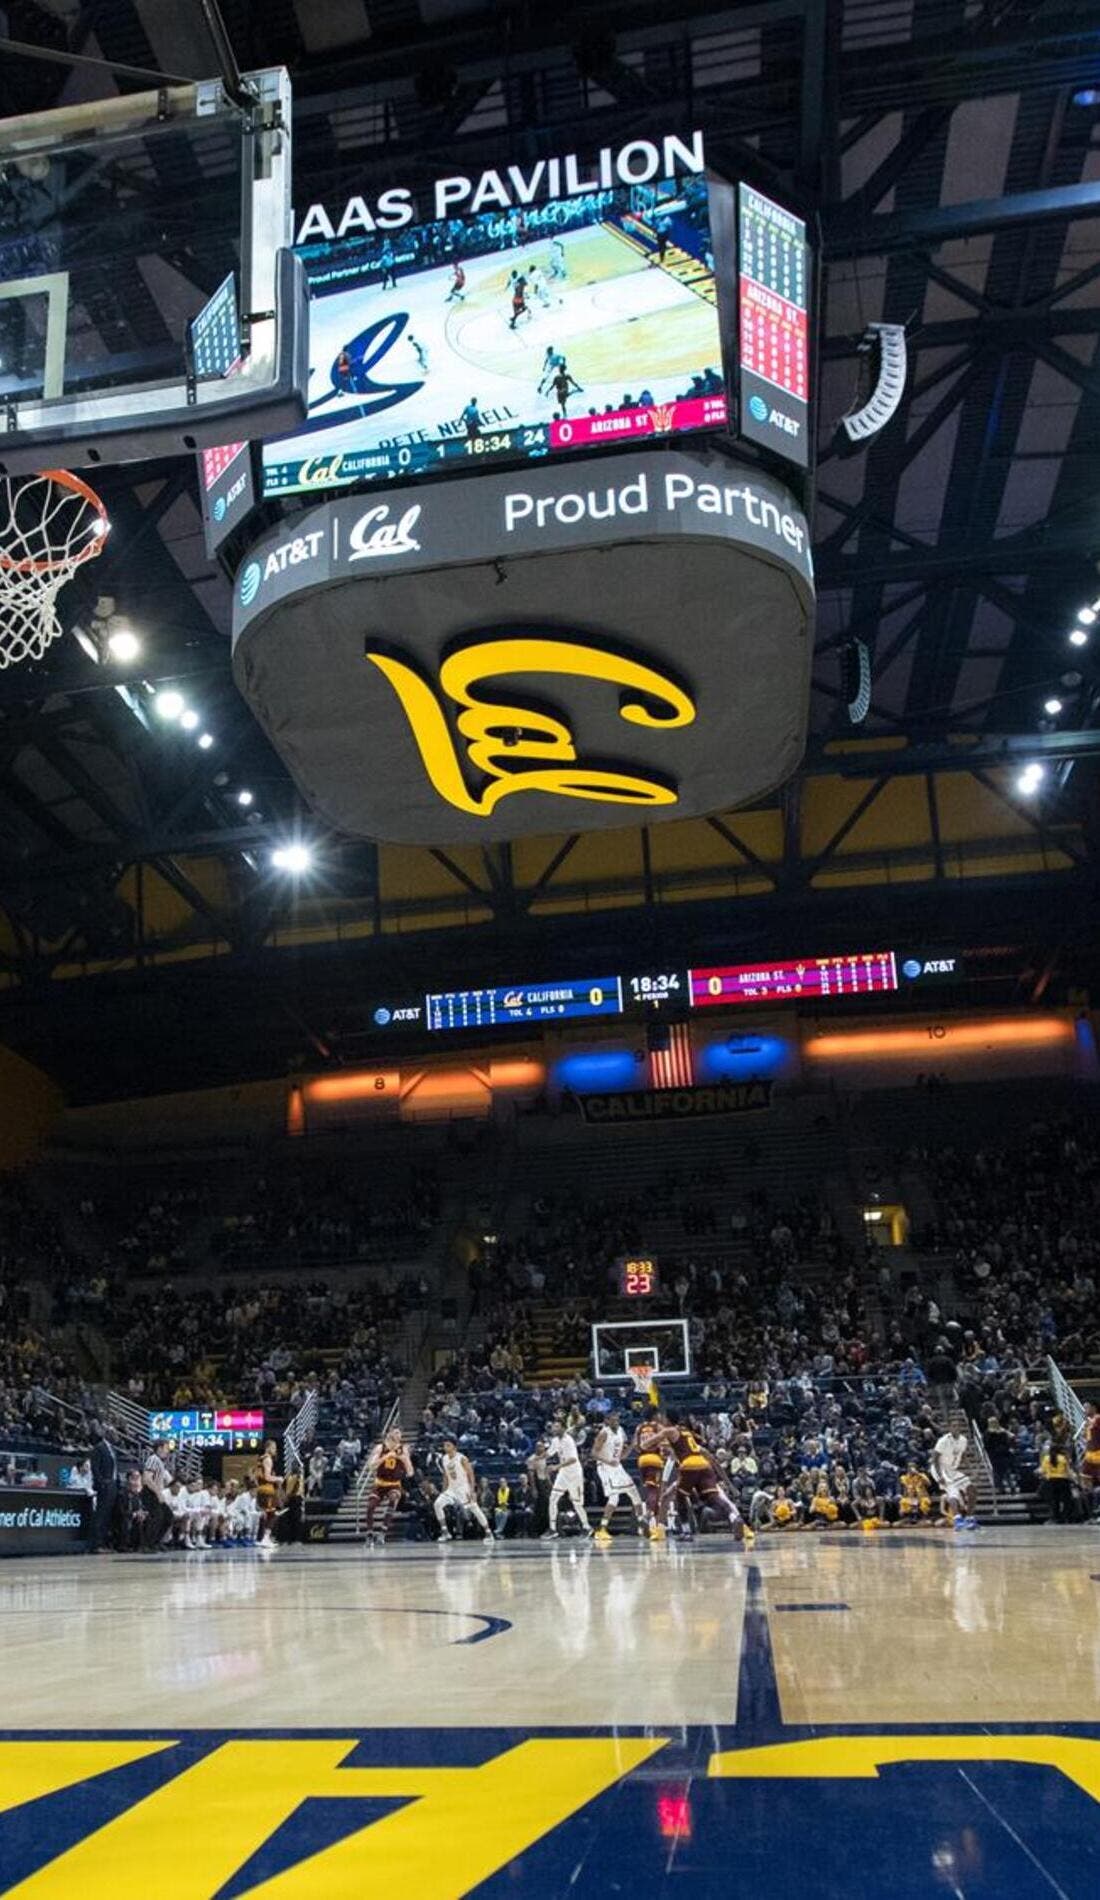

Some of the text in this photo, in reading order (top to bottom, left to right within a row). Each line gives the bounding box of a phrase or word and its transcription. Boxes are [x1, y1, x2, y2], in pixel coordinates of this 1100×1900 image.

[291, 188, 413, 244] AAS
[435, 130, 704, 219] PAVILION
[437, 406, 519, 438] NEELL
[590, 415, 648, 434] ARIZONA ST
[769, 409, 800, 437] AT&T
[523, 429, 545, 446] 24
[558, 423, 572, 442] 0
[436, 444, 445, 458] 1
[464, 434, 512, 455] 18:34
[342, 455, 390, 472] CALIFORNIA
[398, 447, 411, 465] 0
[298, 453, 344, 484] Cal
[226, 472, 246, 508] AT&T
[504, 473, 804, 554] Proud Partner
[349, 504, 421, 561] Cal
[263, 531, 324, 581] AT&T
[365, 638, 697, 817] Cal
[923, 958, 956, 974] AT&T
[630, 973, 680, 993] 18:34
[708, 976, 722, 996] 0
[738, 972, 770, 984] ARIZONA
[503, 990, 523, 1008] Cal
[527, 988, 574, 1004] CALIFORNIA
[590, 987, 603, 1006] 0
[392, 1008, 421, 1021] AT&T
[927, 1025, 946, 1040] 10
[374, 1077, 385, 1090] 8
[586, 1084, 766, 1118] CALIFORNIA
[627, 1261, 652, 1274] 18:33
[627, 1274, 650, 1294] 23
[17, 1508, 29, 1527] of
[29, 1508, 43, 1527] Cal
[45, 1508, 81, 1527] Athletics
